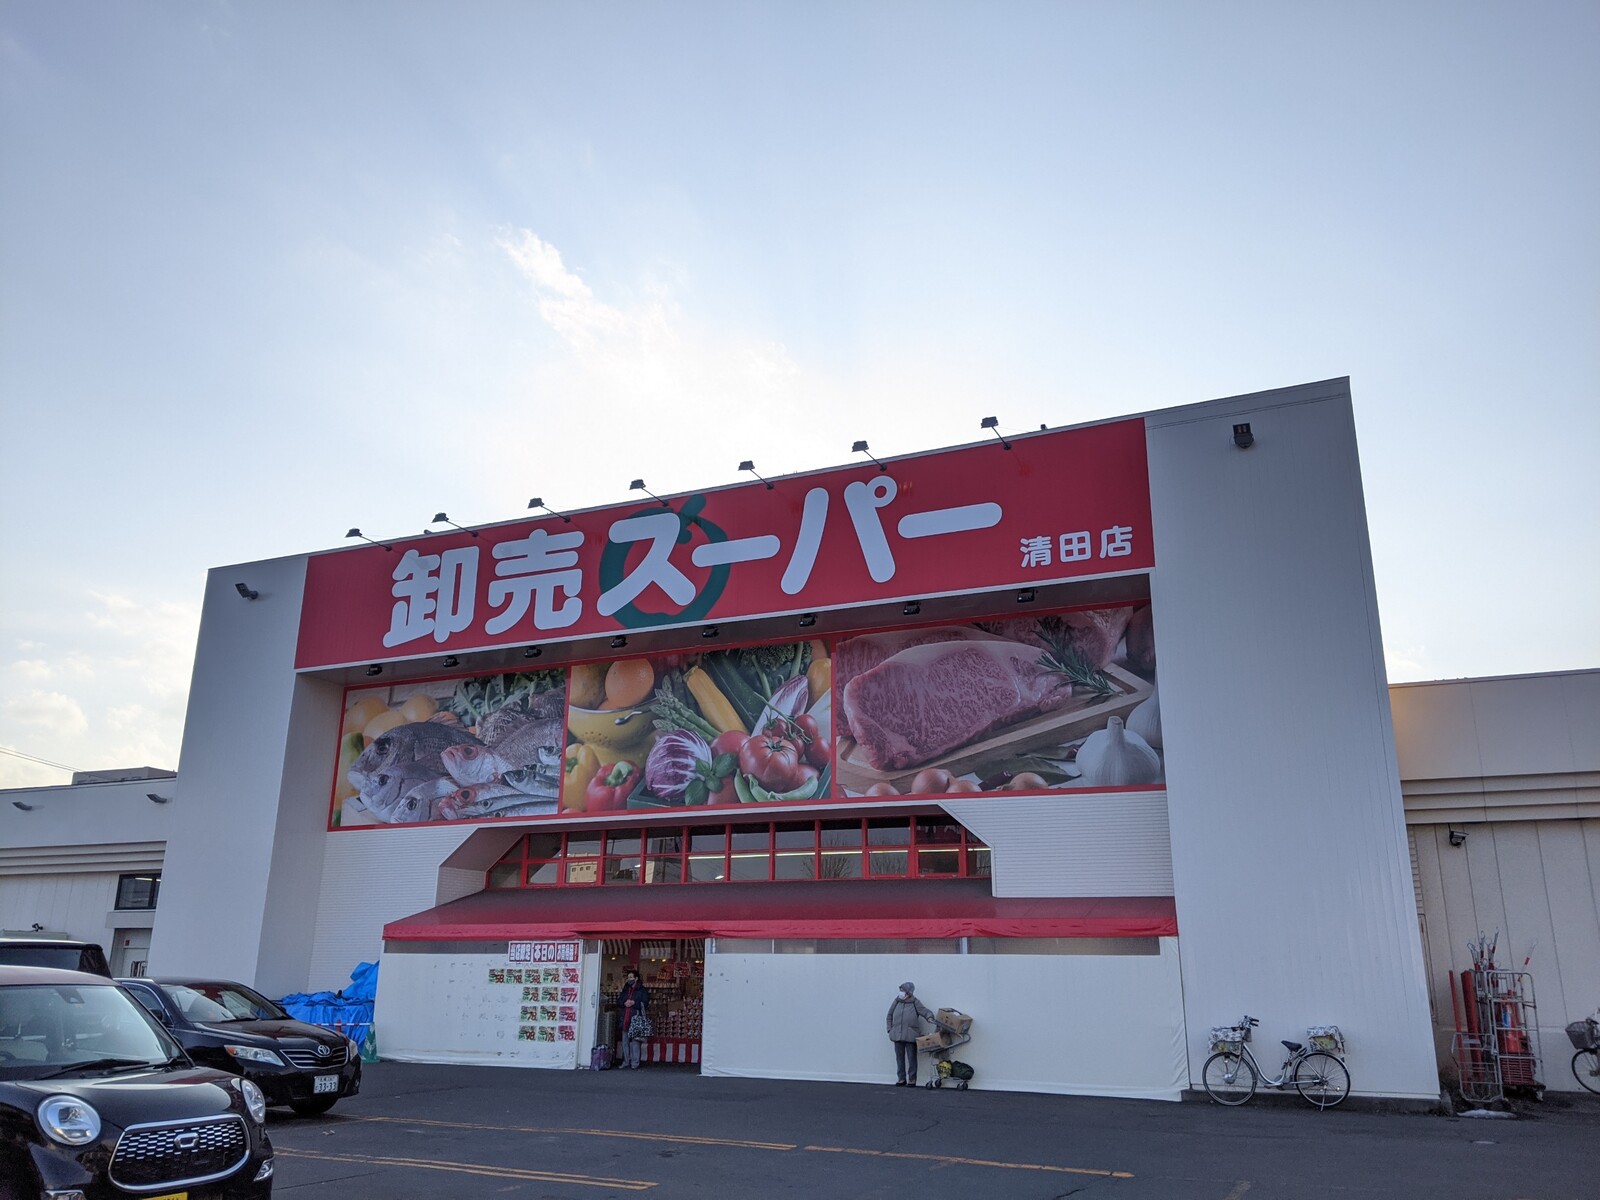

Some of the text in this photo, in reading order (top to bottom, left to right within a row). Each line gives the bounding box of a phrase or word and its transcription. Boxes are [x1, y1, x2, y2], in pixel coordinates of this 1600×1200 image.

[383, 475, 1003, 648] 卸売スーパー
[1019, 525, 1134, 568] 清田店
